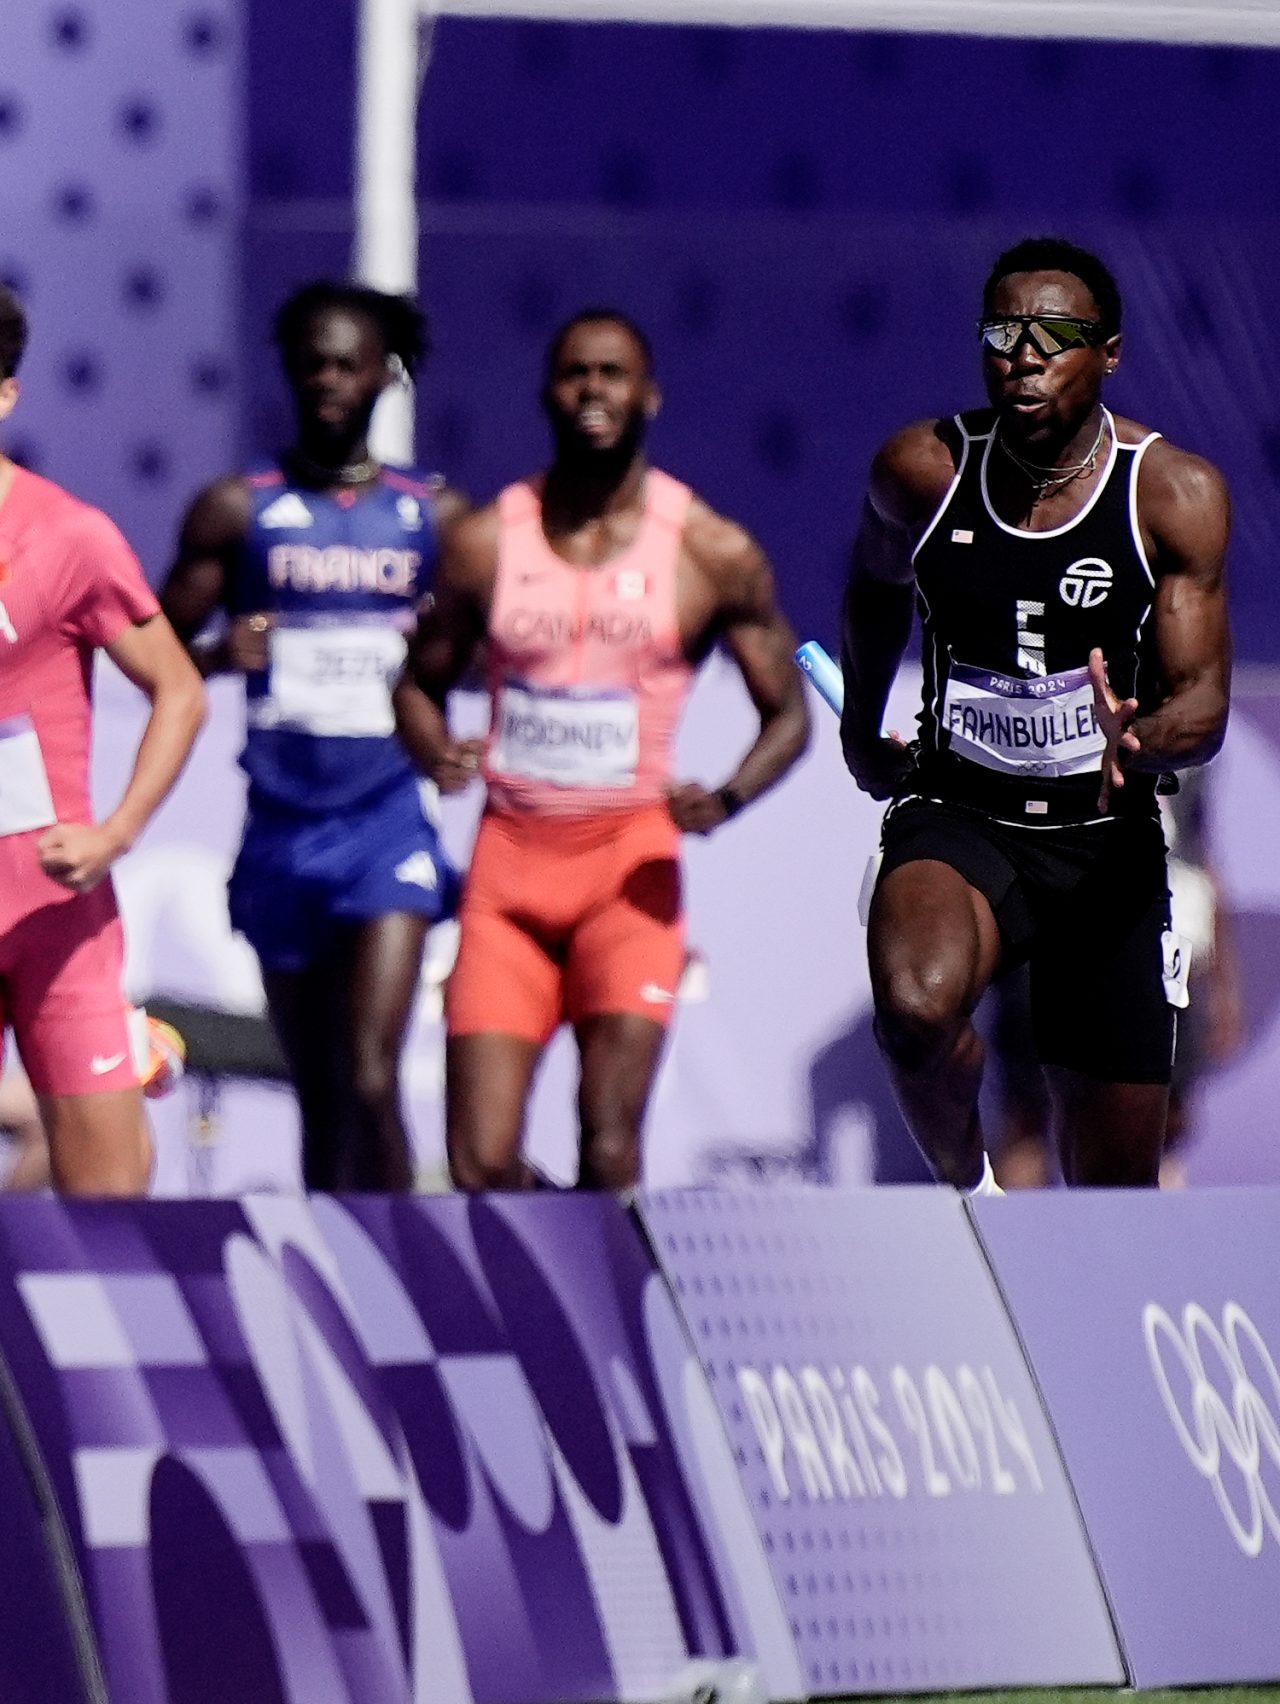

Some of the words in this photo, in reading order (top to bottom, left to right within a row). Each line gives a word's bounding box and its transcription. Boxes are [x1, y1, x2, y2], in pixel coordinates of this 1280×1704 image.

[989, 676, 1024, 695] PARIS
[1027, 679, 1067, 698] 2024
[889, 1364, 1045, 1498] 2024
